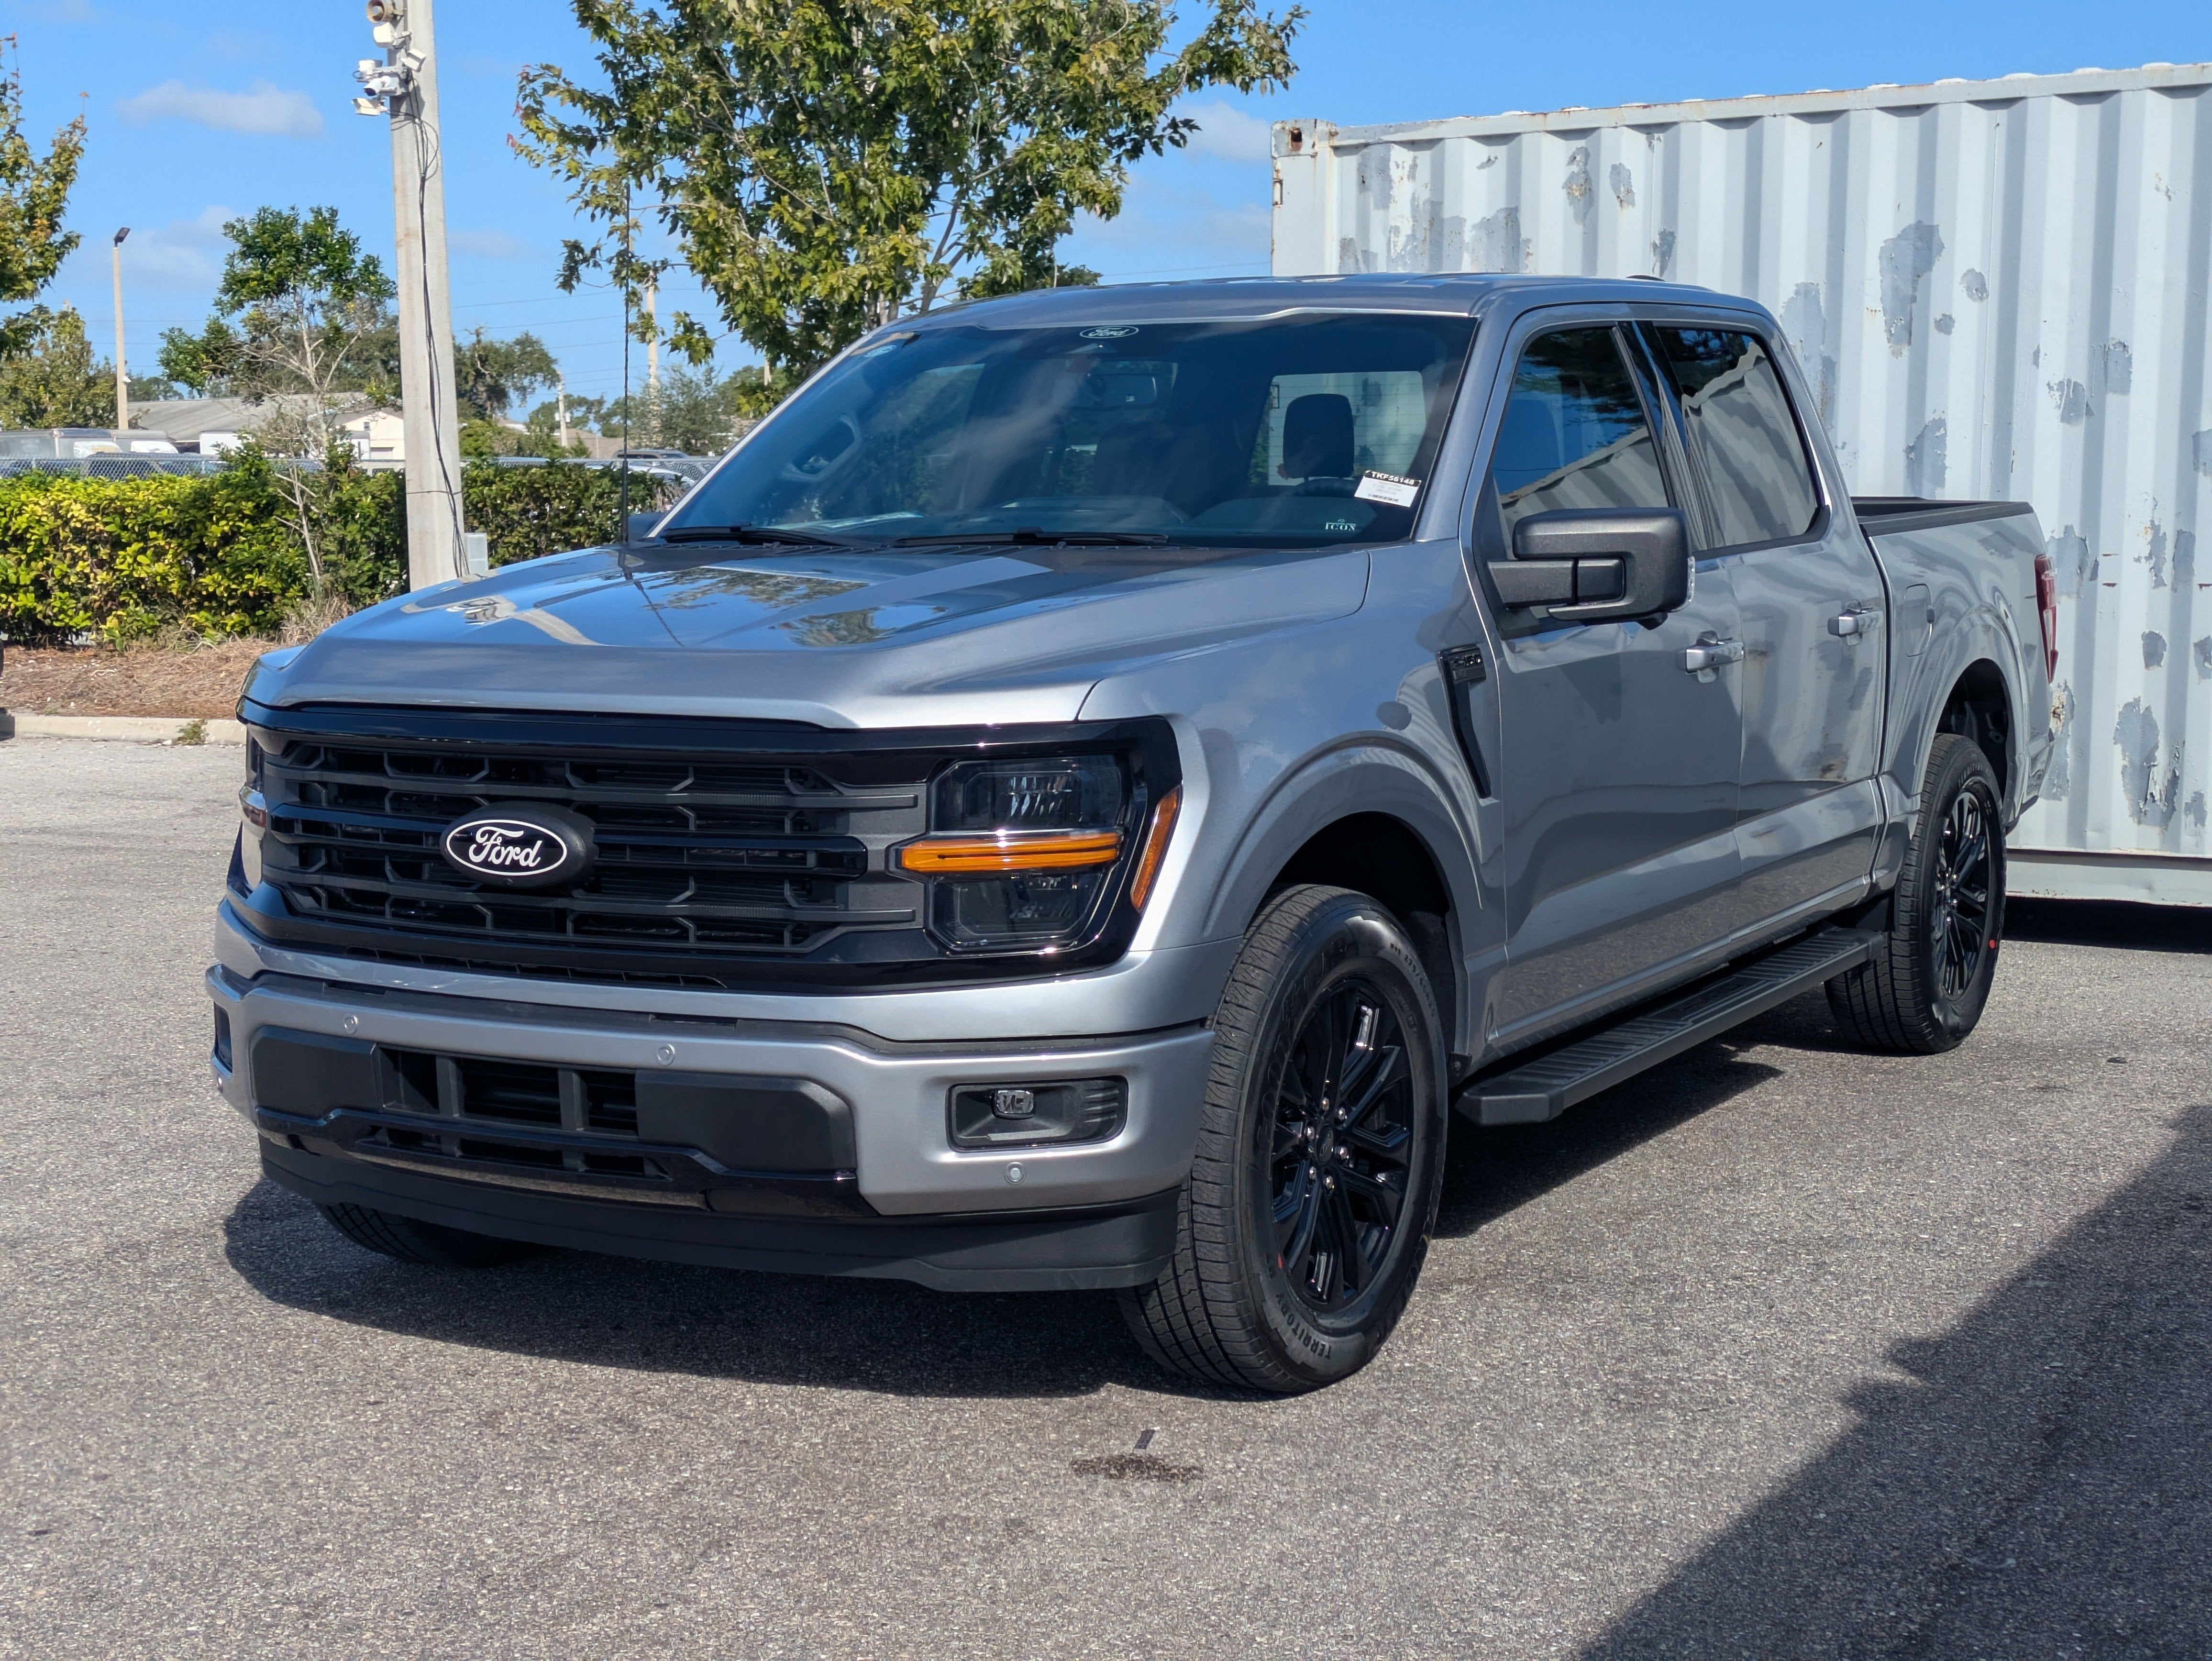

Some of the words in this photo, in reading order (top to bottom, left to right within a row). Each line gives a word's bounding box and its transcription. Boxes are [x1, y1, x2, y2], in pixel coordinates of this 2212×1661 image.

[1088, 327, 1130, 337] Ford
[469, 826, 543, 867] Ford
[1275, 1293, 1332, 1360] TERRITORY
